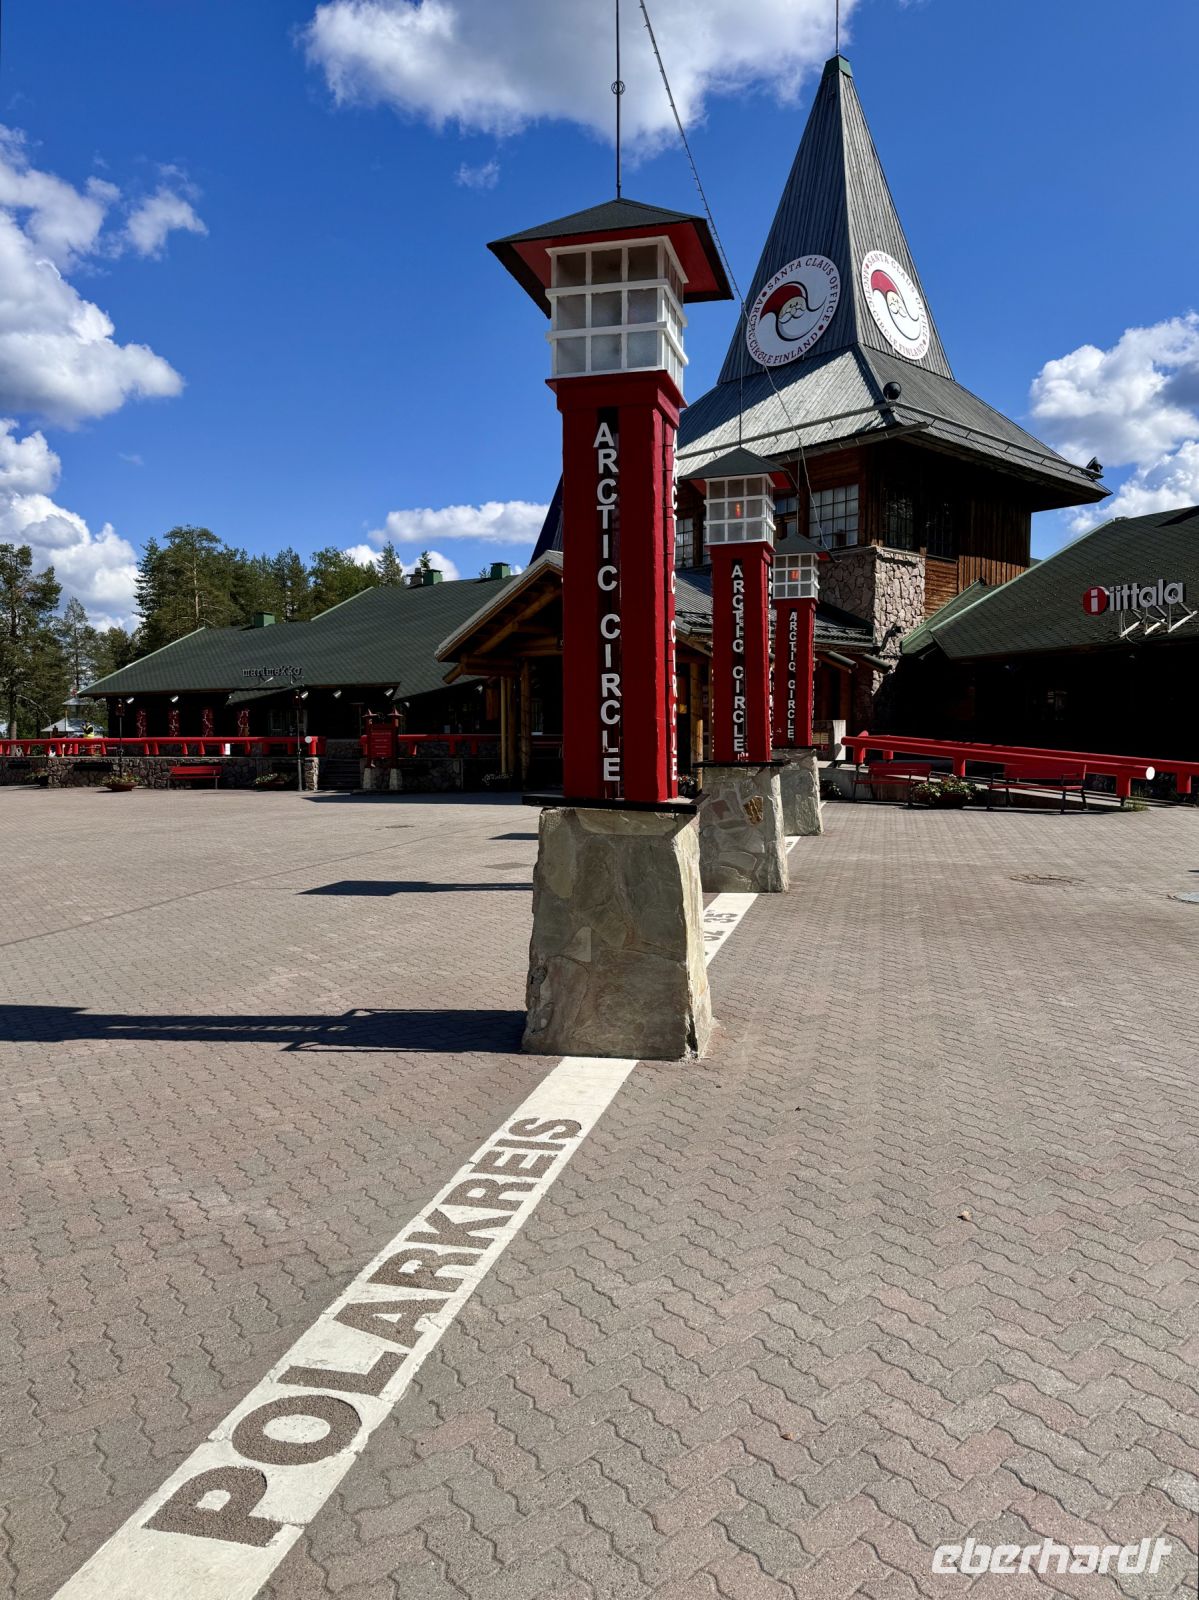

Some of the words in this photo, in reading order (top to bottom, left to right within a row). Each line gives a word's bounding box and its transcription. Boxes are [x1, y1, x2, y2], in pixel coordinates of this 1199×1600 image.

[767, 260, 802, 291] SANTA
[805, 257, 834, 276] CLAUS
[823, 276, 838, 322] OFFICE
[867, 253, 889, 266] SANTA
[891, 260, 914, 293] CLAUS
[773, 332, 818, 363] FINLAND
[593, 422, 619, 591] ARCTIC
[731, 565, 746, 653] ARCTIC
[1109, 578, 1185, 612] iittala
[242, 665, 302, 677] marimekko
[788, 611, 798, 672] ARCTIC
[600, 613, 622, 782] CIRCLE
[670, 620, 678, 781] CIRCLE
[732, 666, 746, 752] CIRCLE
[787, 680, 797, 739] CIRCLE
[141, 1117, 582, 1548] POLARKREIS
